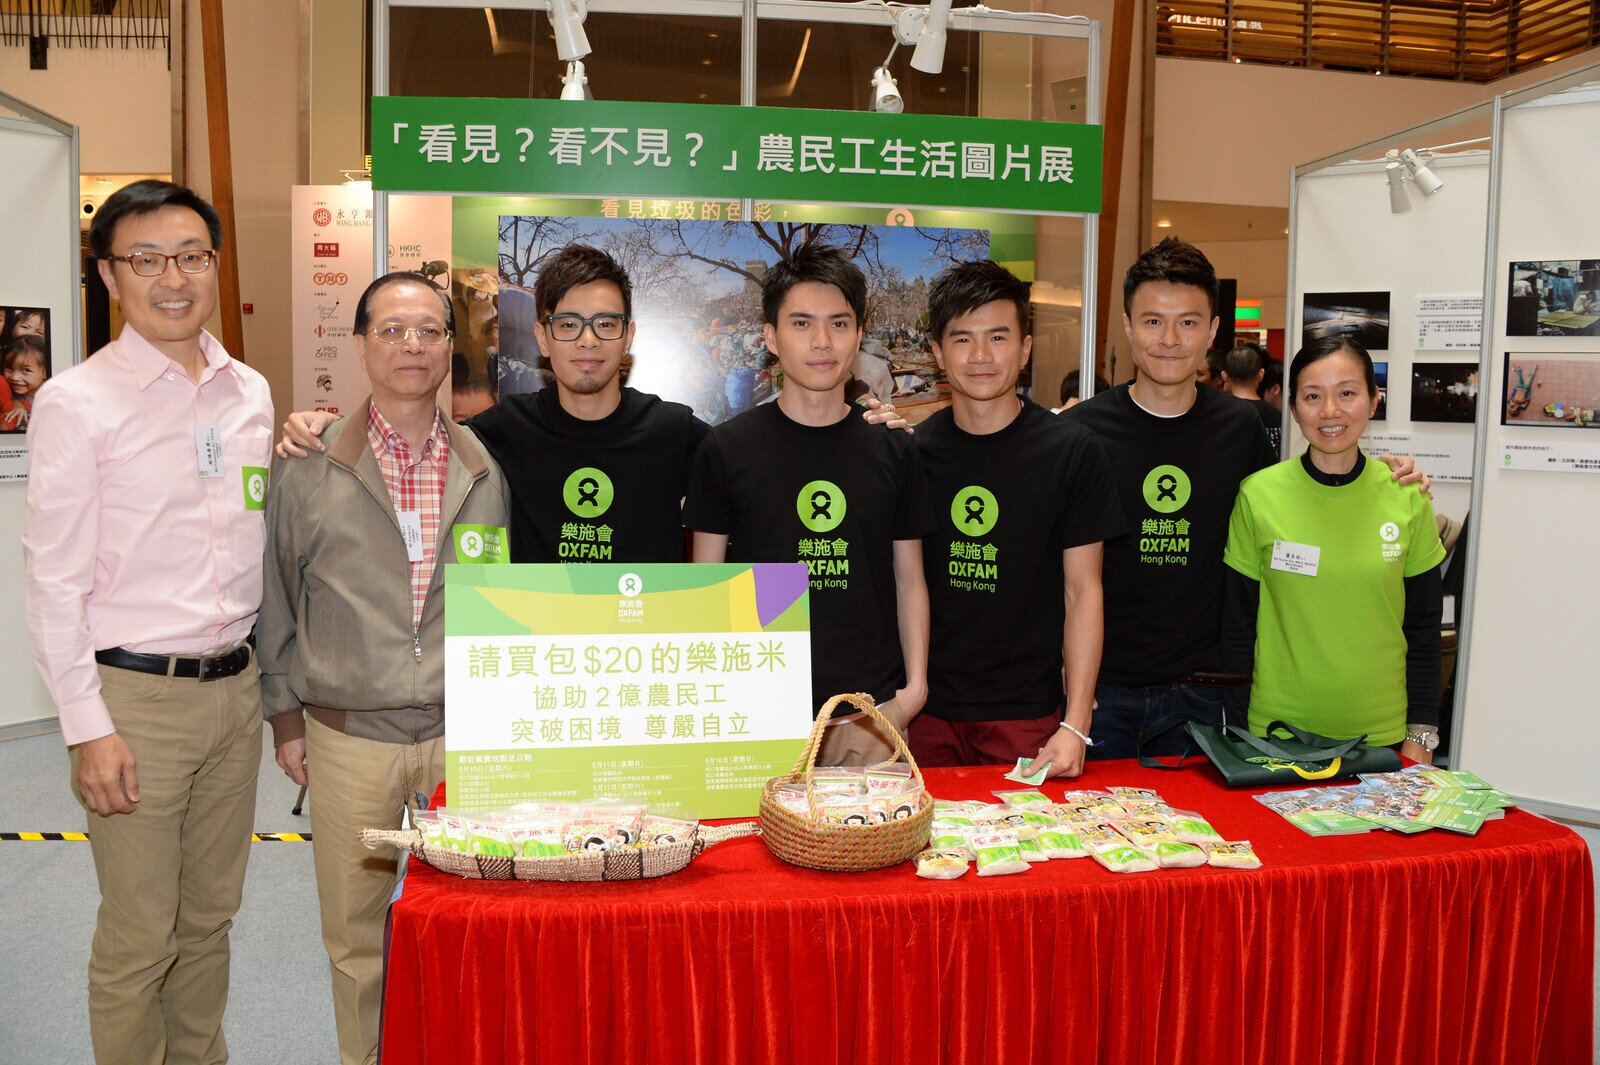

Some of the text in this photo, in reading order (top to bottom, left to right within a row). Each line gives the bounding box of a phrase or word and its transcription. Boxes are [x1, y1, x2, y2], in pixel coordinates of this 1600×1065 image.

[560, 522, 614, 543] 樂施會
[1141, 518, 1190, 536] 樂施會
[558, 541, 613, 560] OXFAM
[798, 537, 849, 558] 樂施會
[949, 540, 999, 562] 樂施會
[1139, 537, 1190, 553] OXFAM
[798, 559, 849, 576] XFAM
[1140, 554, 1188, 566] Hong Kong
[948, 560, 998, 580] OXFAM
[824, 577, 848, 590] Kong
[950, 578, 996, 593] Hong Kong
[618, 609, 644, 617] OXFAM
[468, 639, 787, 678] 請買包$20的樂施米
[533, 682, 727, 711] 協助2億農民工
[511, 712, 751, 743] 突破困境 尊嚴自立
